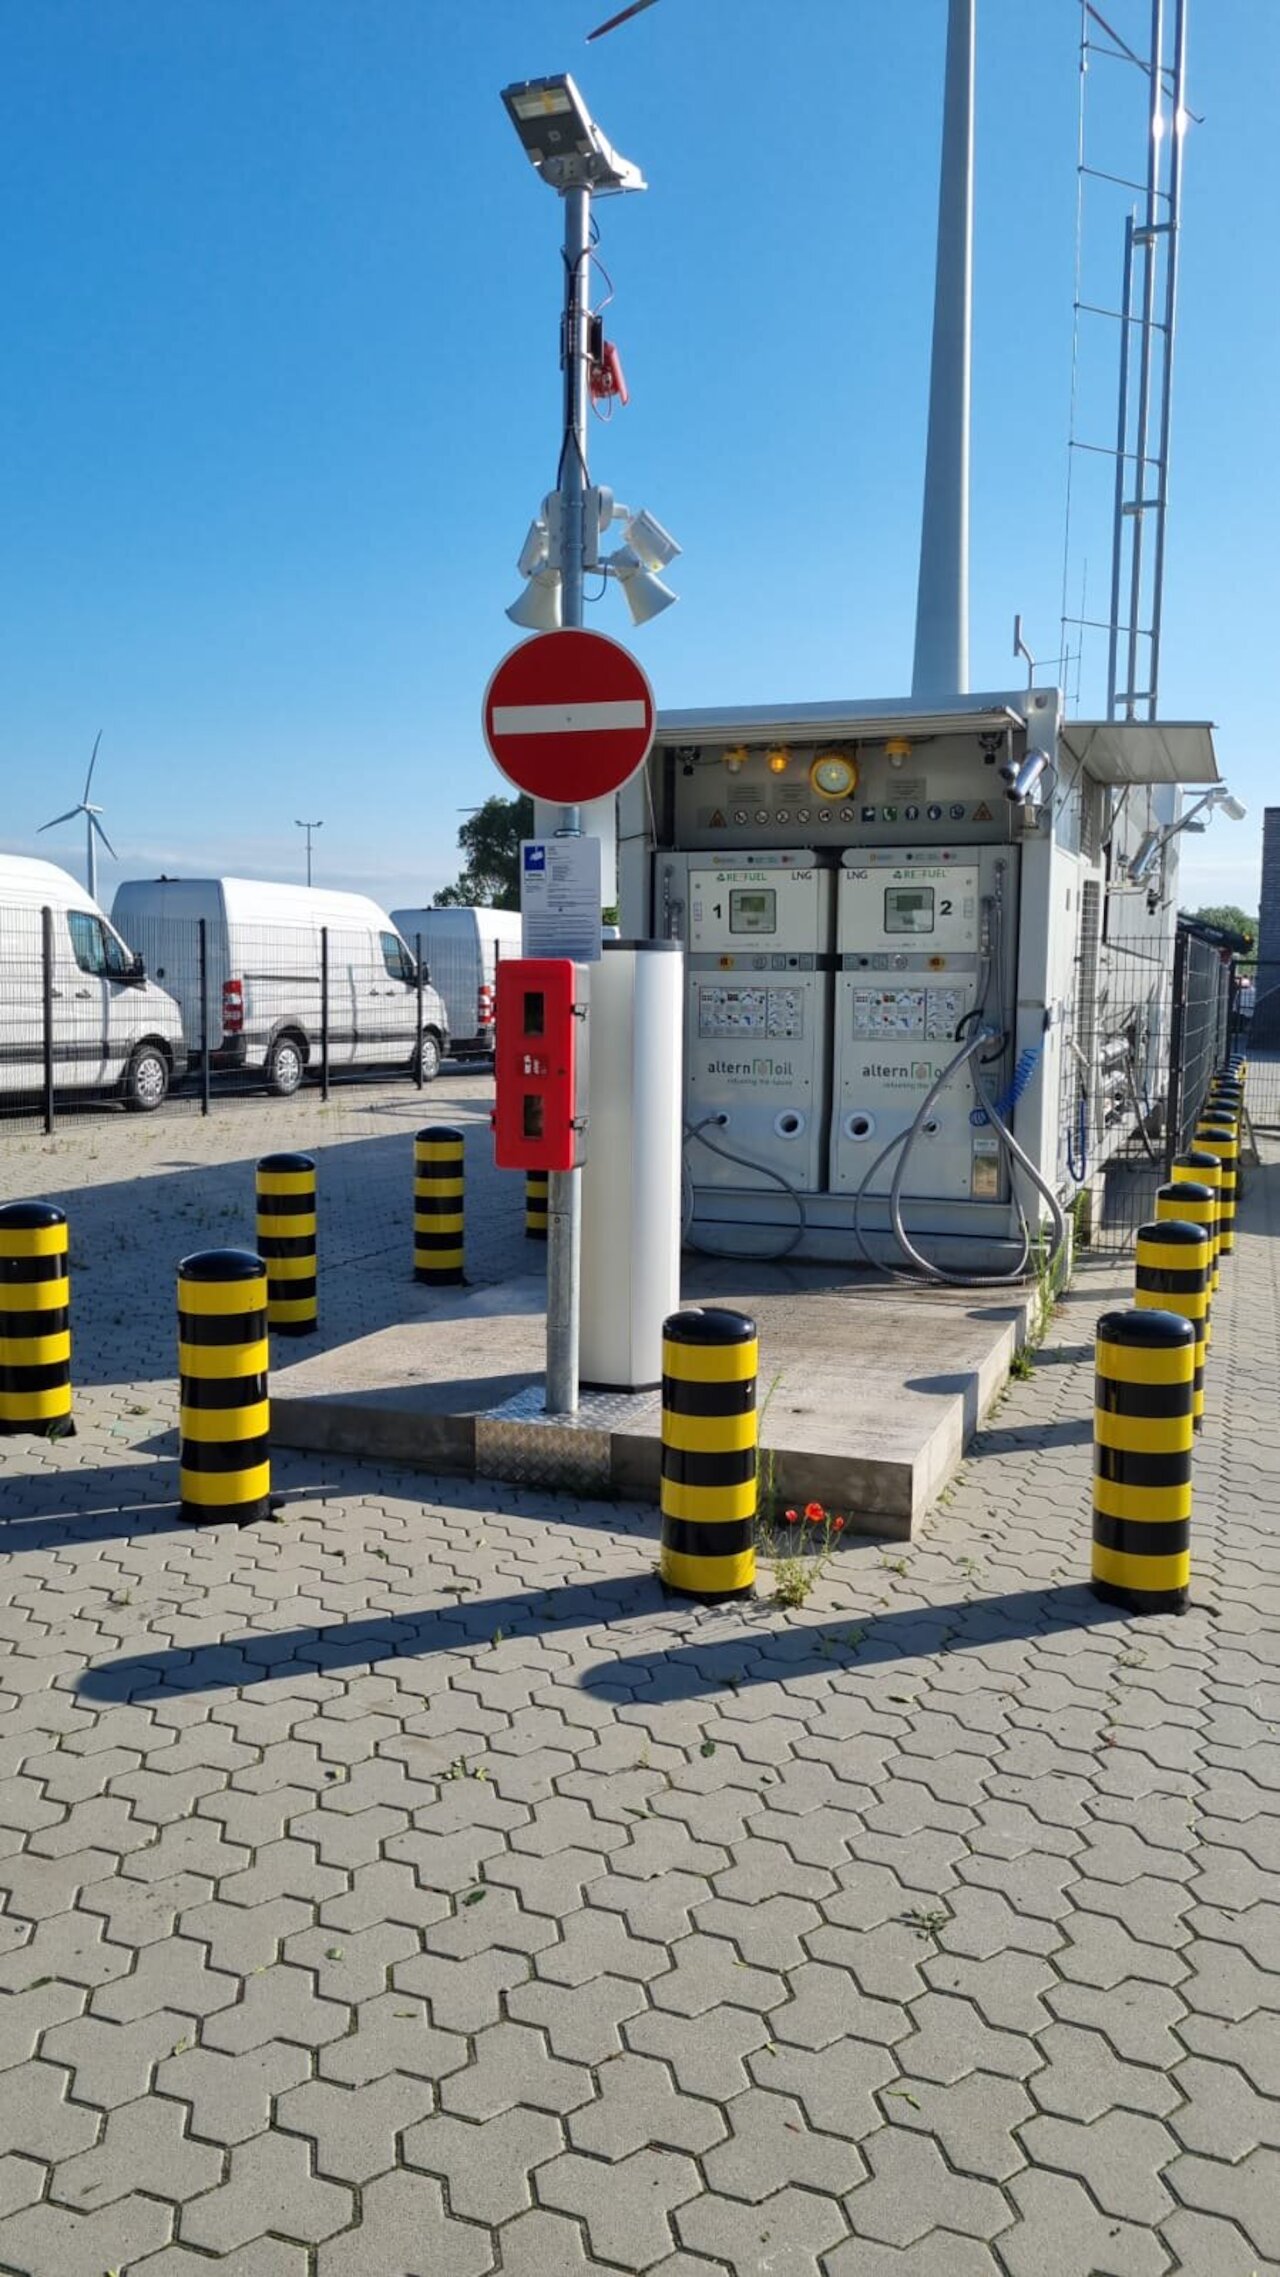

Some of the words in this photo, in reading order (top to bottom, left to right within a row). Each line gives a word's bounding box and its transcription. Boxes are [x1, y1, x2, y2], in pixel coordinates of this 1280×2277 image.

[791, 871, 812, 881] LNG
[846, 870, 868, 880] LNG
[713, 903, 722, 919] 1
[940, 900, 953, 916] 2
